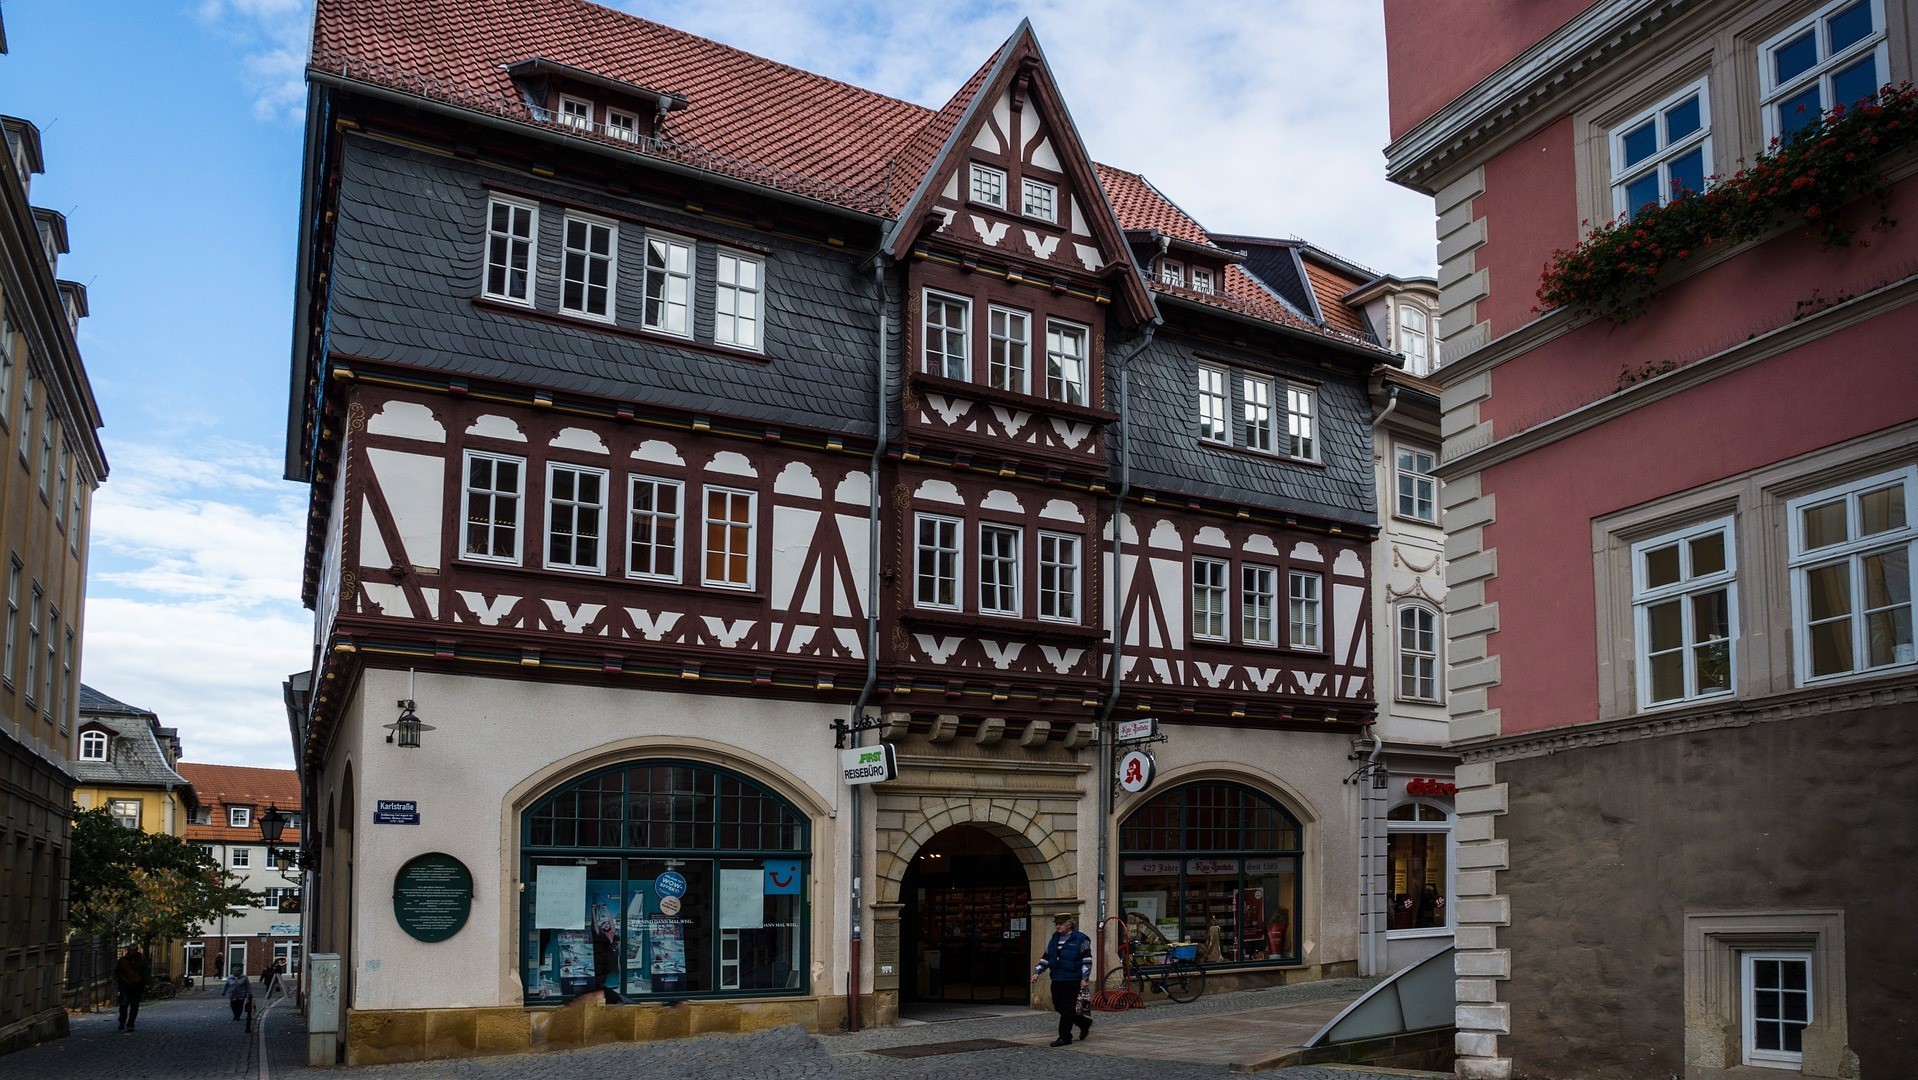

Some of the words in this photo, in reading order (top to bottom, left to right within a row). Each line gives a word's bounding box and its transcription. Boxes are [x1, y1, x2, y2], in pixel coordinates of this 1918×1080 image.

[859, 751, 882, 764] FIRST
[844, 764, 884, 780] REISEBÜRO
[380, 802, 414, 811] Karlstraße
[1142, 864, 1156, 872] 427
[1157, 863, 1179, 873] Jahre
[662, 877, 683, 889] WOW-
